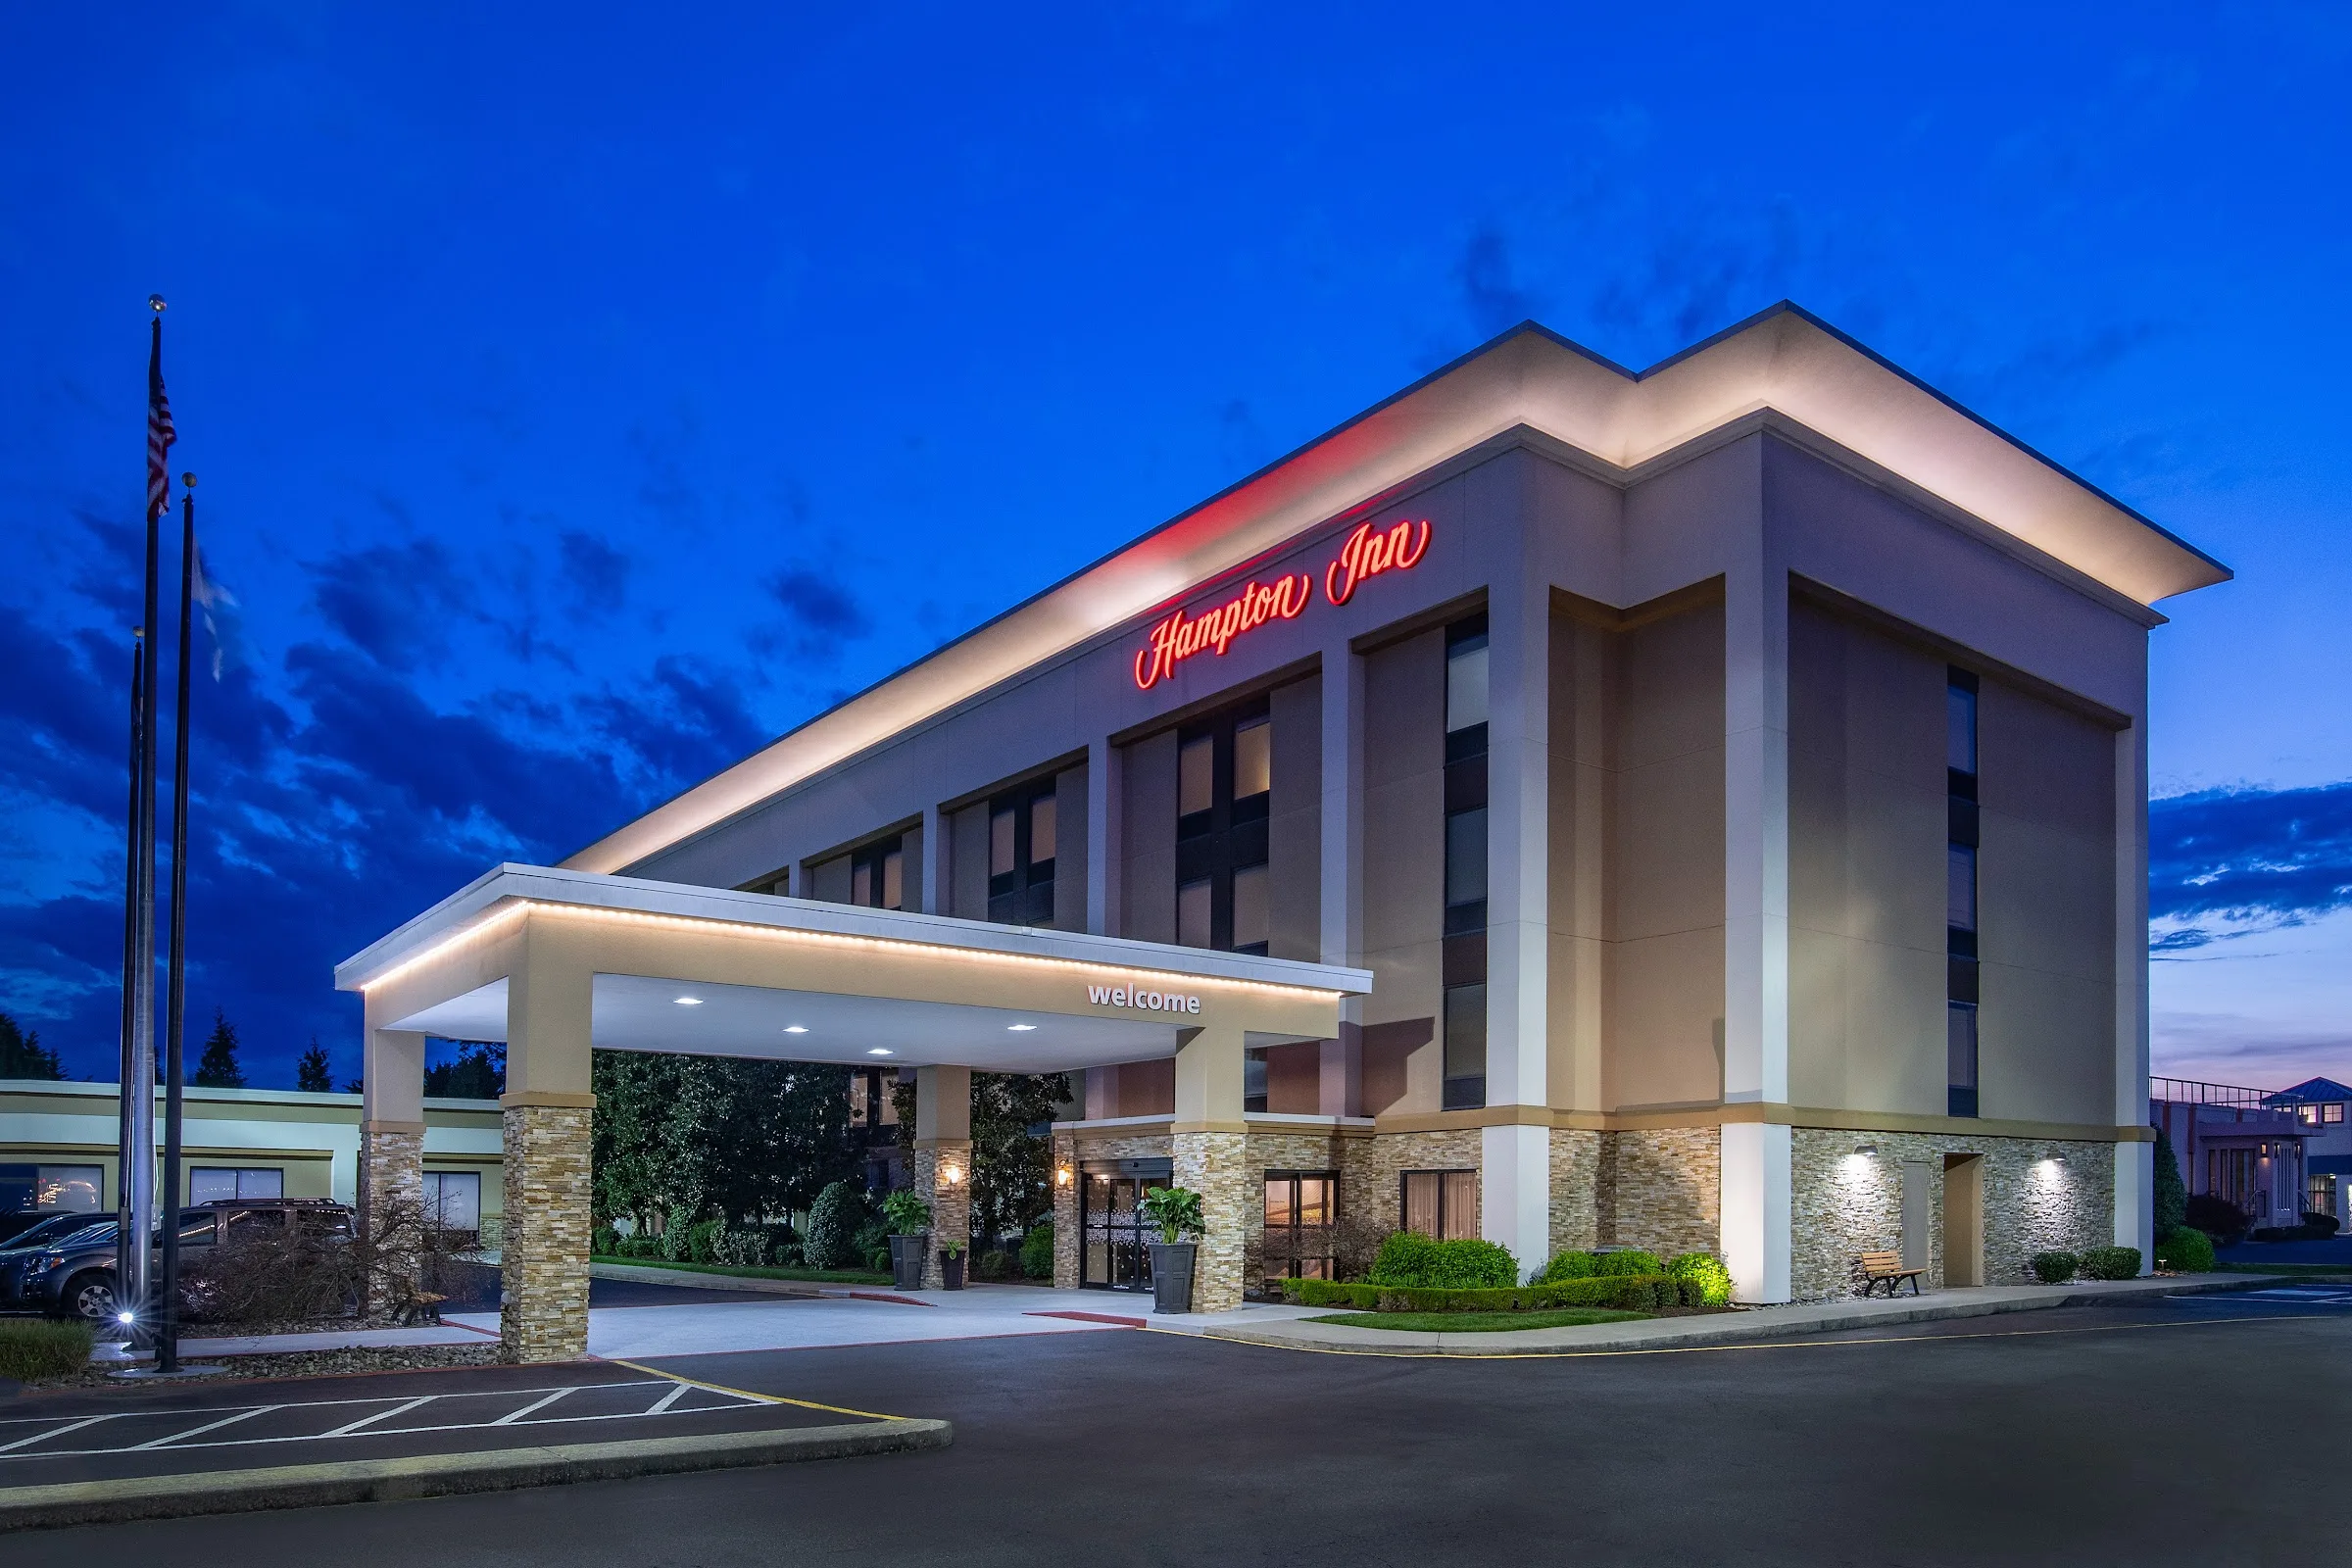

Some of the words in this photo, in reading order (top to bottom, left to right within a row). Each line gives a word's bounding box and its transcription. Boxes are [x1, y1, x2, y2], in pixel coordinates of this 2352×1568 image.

[1135, 574, 1312, 689] Hampton
[1326, 519, 1432, 606] Inn
[1088, 983, 1200, 1014] welcome
